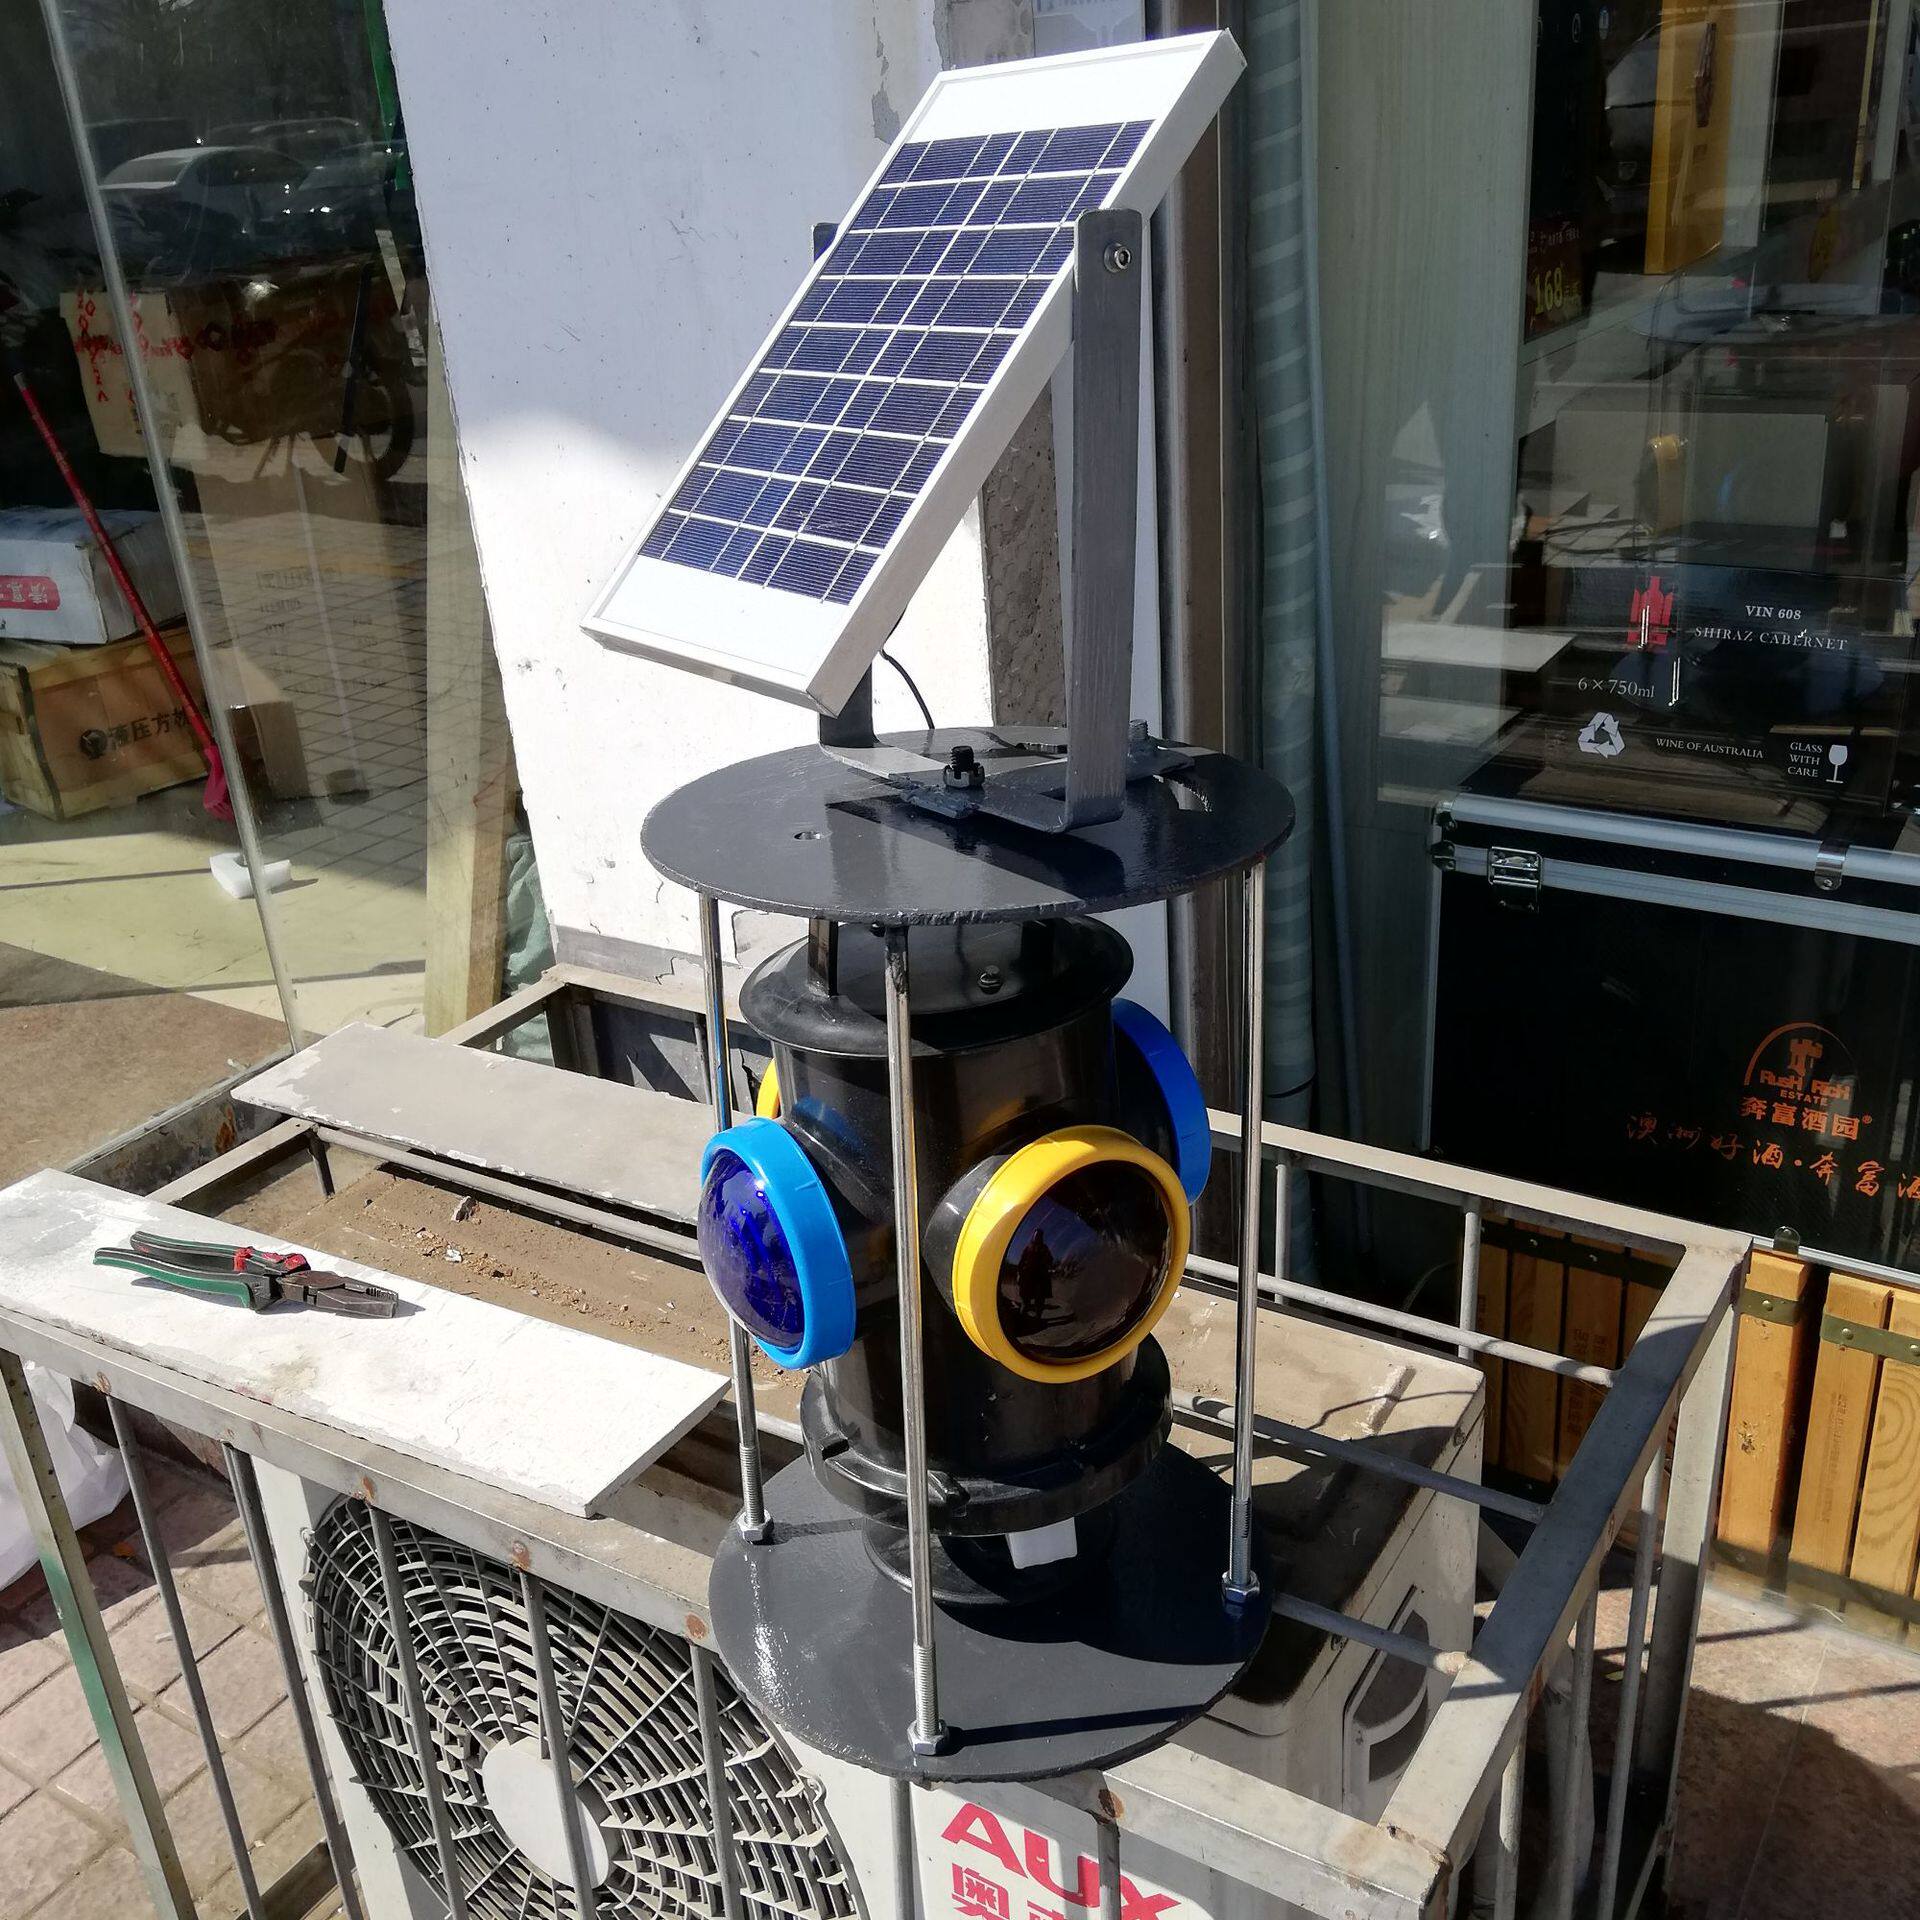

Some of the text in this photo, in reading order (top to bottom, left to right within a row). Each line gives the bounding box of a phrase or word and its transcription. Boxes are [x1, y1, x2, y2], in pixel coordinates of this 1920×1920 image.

[1534, 267, 1564, 315] 168
[1745, 605, 1802, 620] VIN 608
[1694, 626, 1848, 650] SHIRAZ CABERNET
[1656, 738, 1764, 759] WINE OF AUSTRALIA
[1790, 741, 1823, 753] GLASS
[1790, 754, 1820, 765] WITH
[1788, 766, 1819, 777] CARE
[1780, 1089, 1828, 1106] ESTATE
[941, 1802, 1182, 1920] AUX
